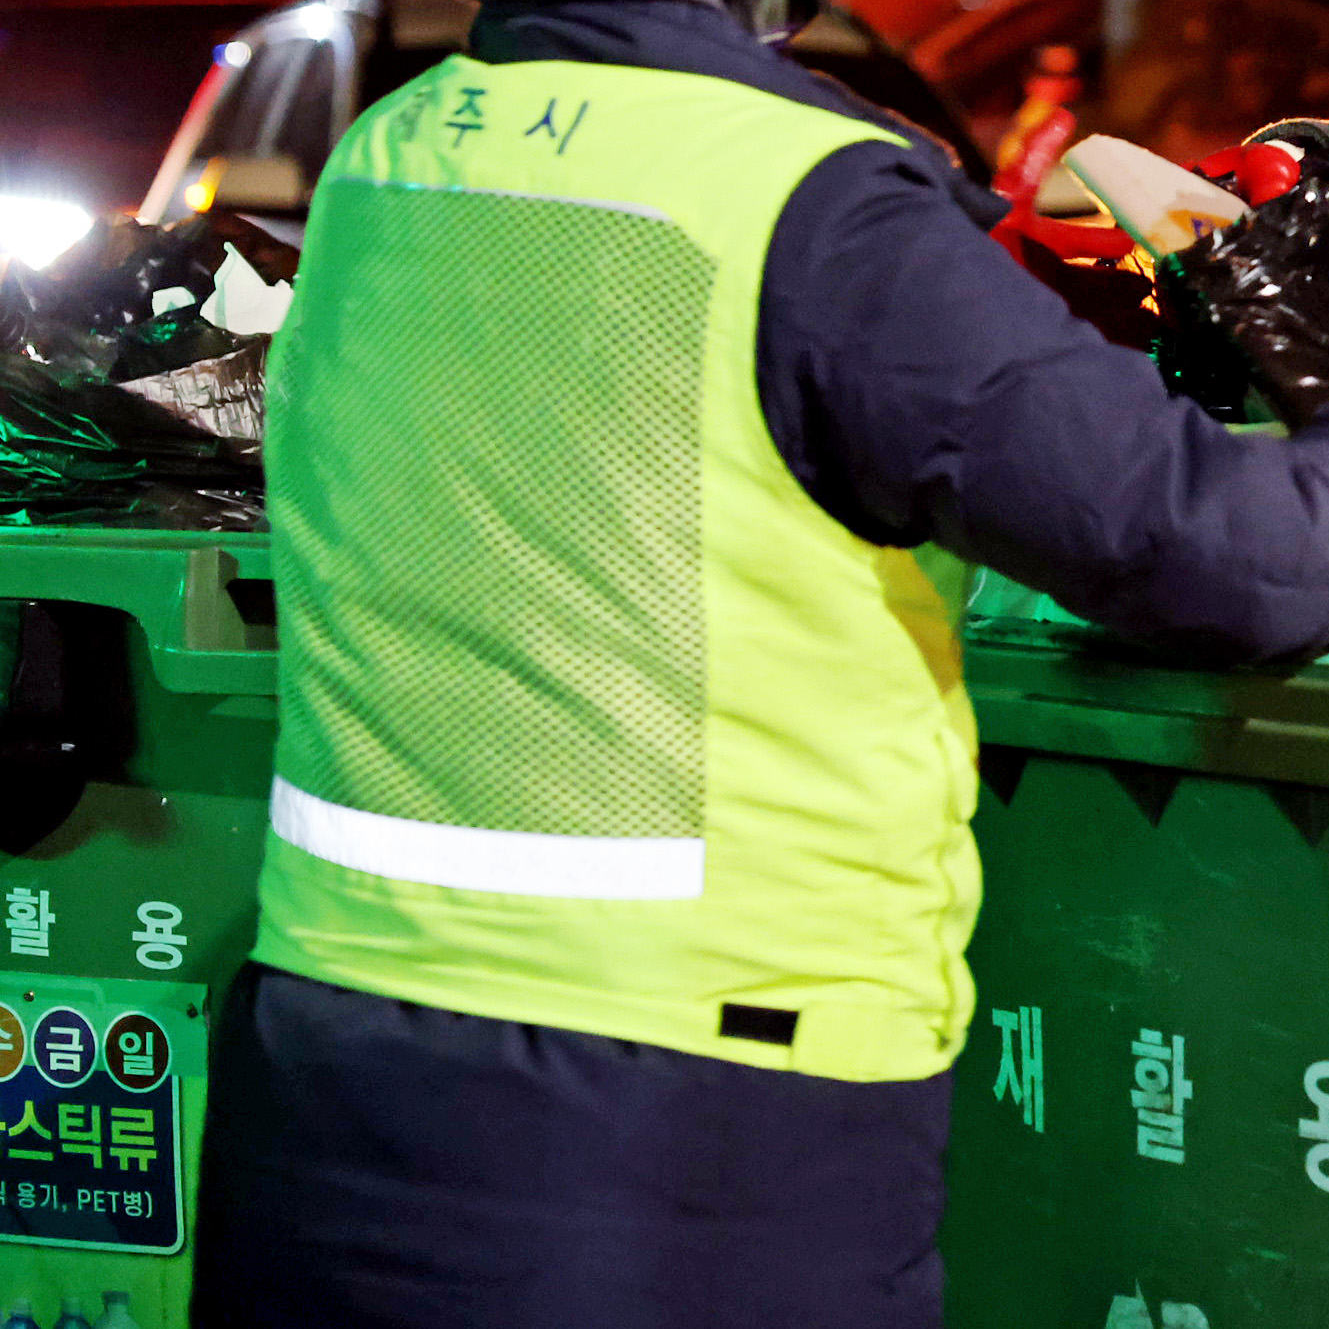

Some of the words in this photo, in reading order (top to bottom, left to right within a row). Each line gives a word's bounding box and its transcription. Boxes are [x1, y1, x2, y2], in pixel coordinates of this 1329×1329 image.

[46, 1026, 84, 1072] 금
[118, 1031, 155, 1076] 일
[0, 1100, 157, 1172] 스틱류
[77, 1189, 153, 1218] PET병)
